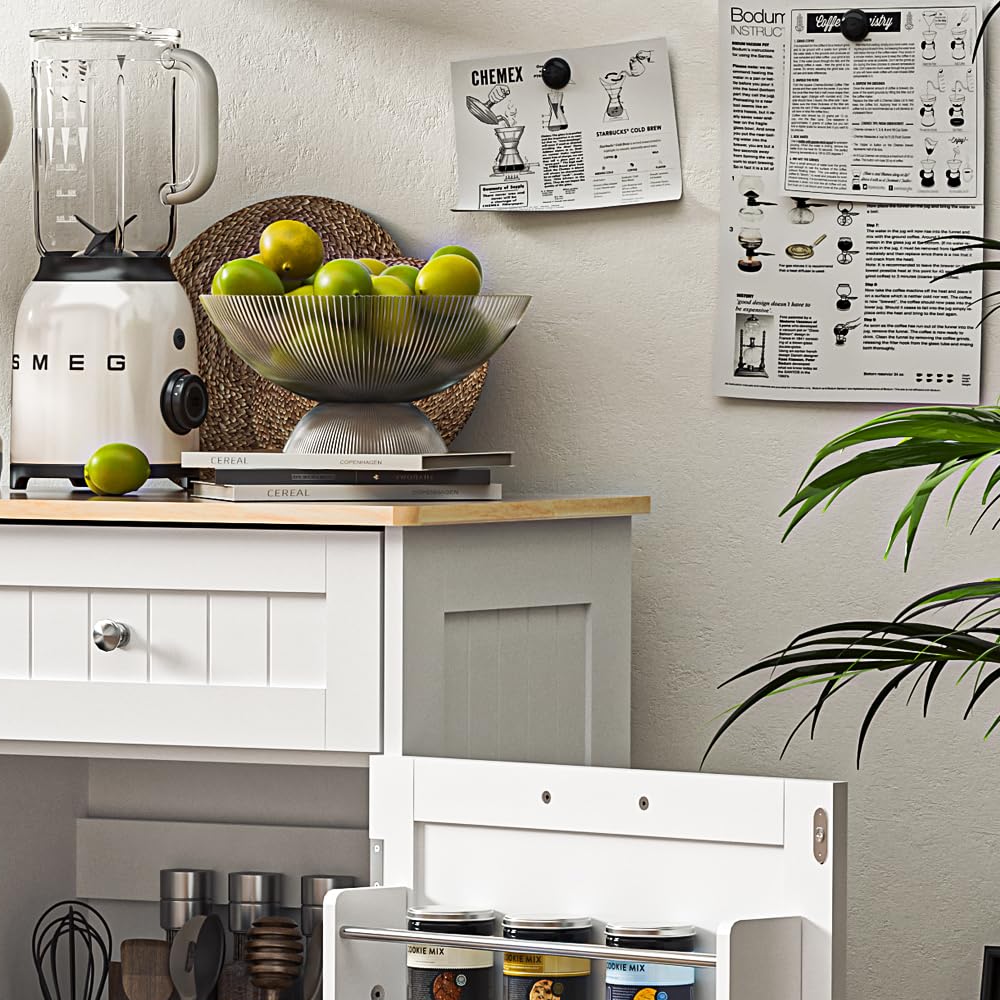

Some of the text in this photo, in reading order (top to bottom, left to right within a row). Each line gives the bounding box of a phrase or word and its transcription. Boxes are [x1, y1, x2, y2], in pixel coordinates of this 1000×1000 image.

[731, 25, 785, 38] INSTRUC
[471, 66, 524, 86] CHEMEX
[12, 354, 126, 371] SMEG
[210, 456, 248, 464] CEREAL
[267, 489, 310, 497] CEREAL
[429, 948, 444, 956] MIX
